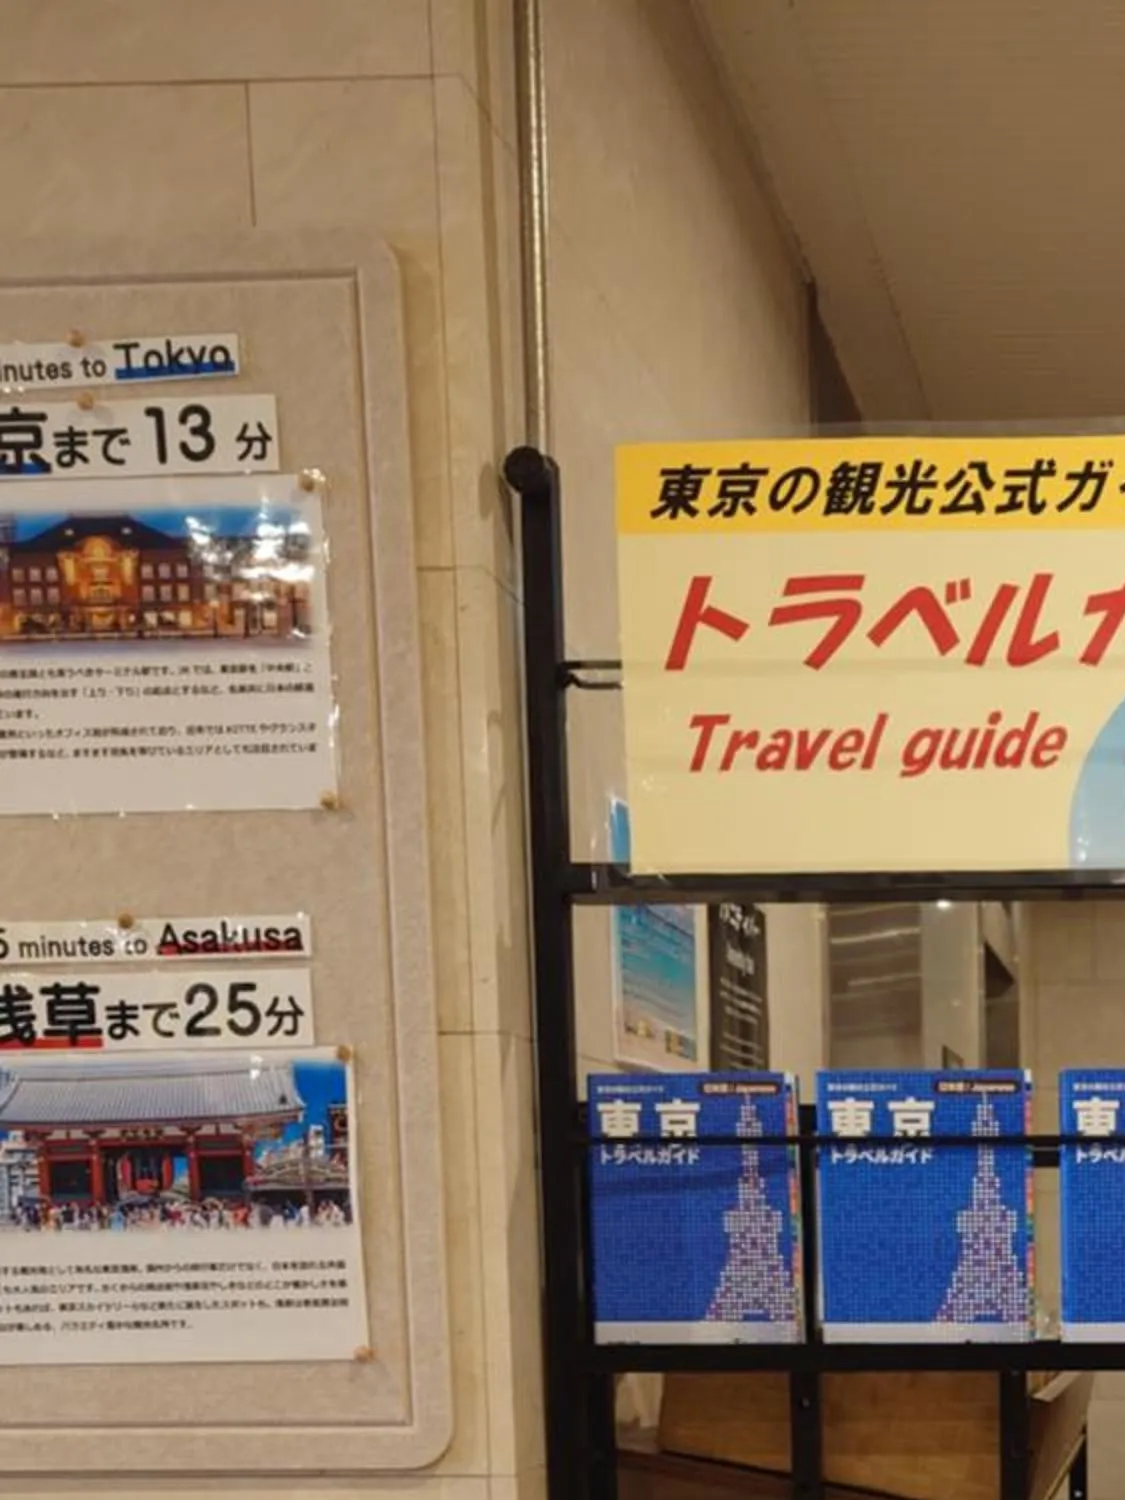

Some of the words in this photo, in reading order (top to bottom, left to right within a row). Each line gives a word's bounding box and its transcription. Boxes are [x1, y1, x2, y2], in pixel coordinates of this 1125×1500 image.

[0, 359, 72, 382] nutes
[81, 357, 107, 378] to
[113, 339, 232, 372] Tokyo
[688, 714, 888, 772] Travel
[900, 712, 1067, 777] guide
[19, 935, 114, 958] minutes
[158, 921, 304, 955] Asakusa
